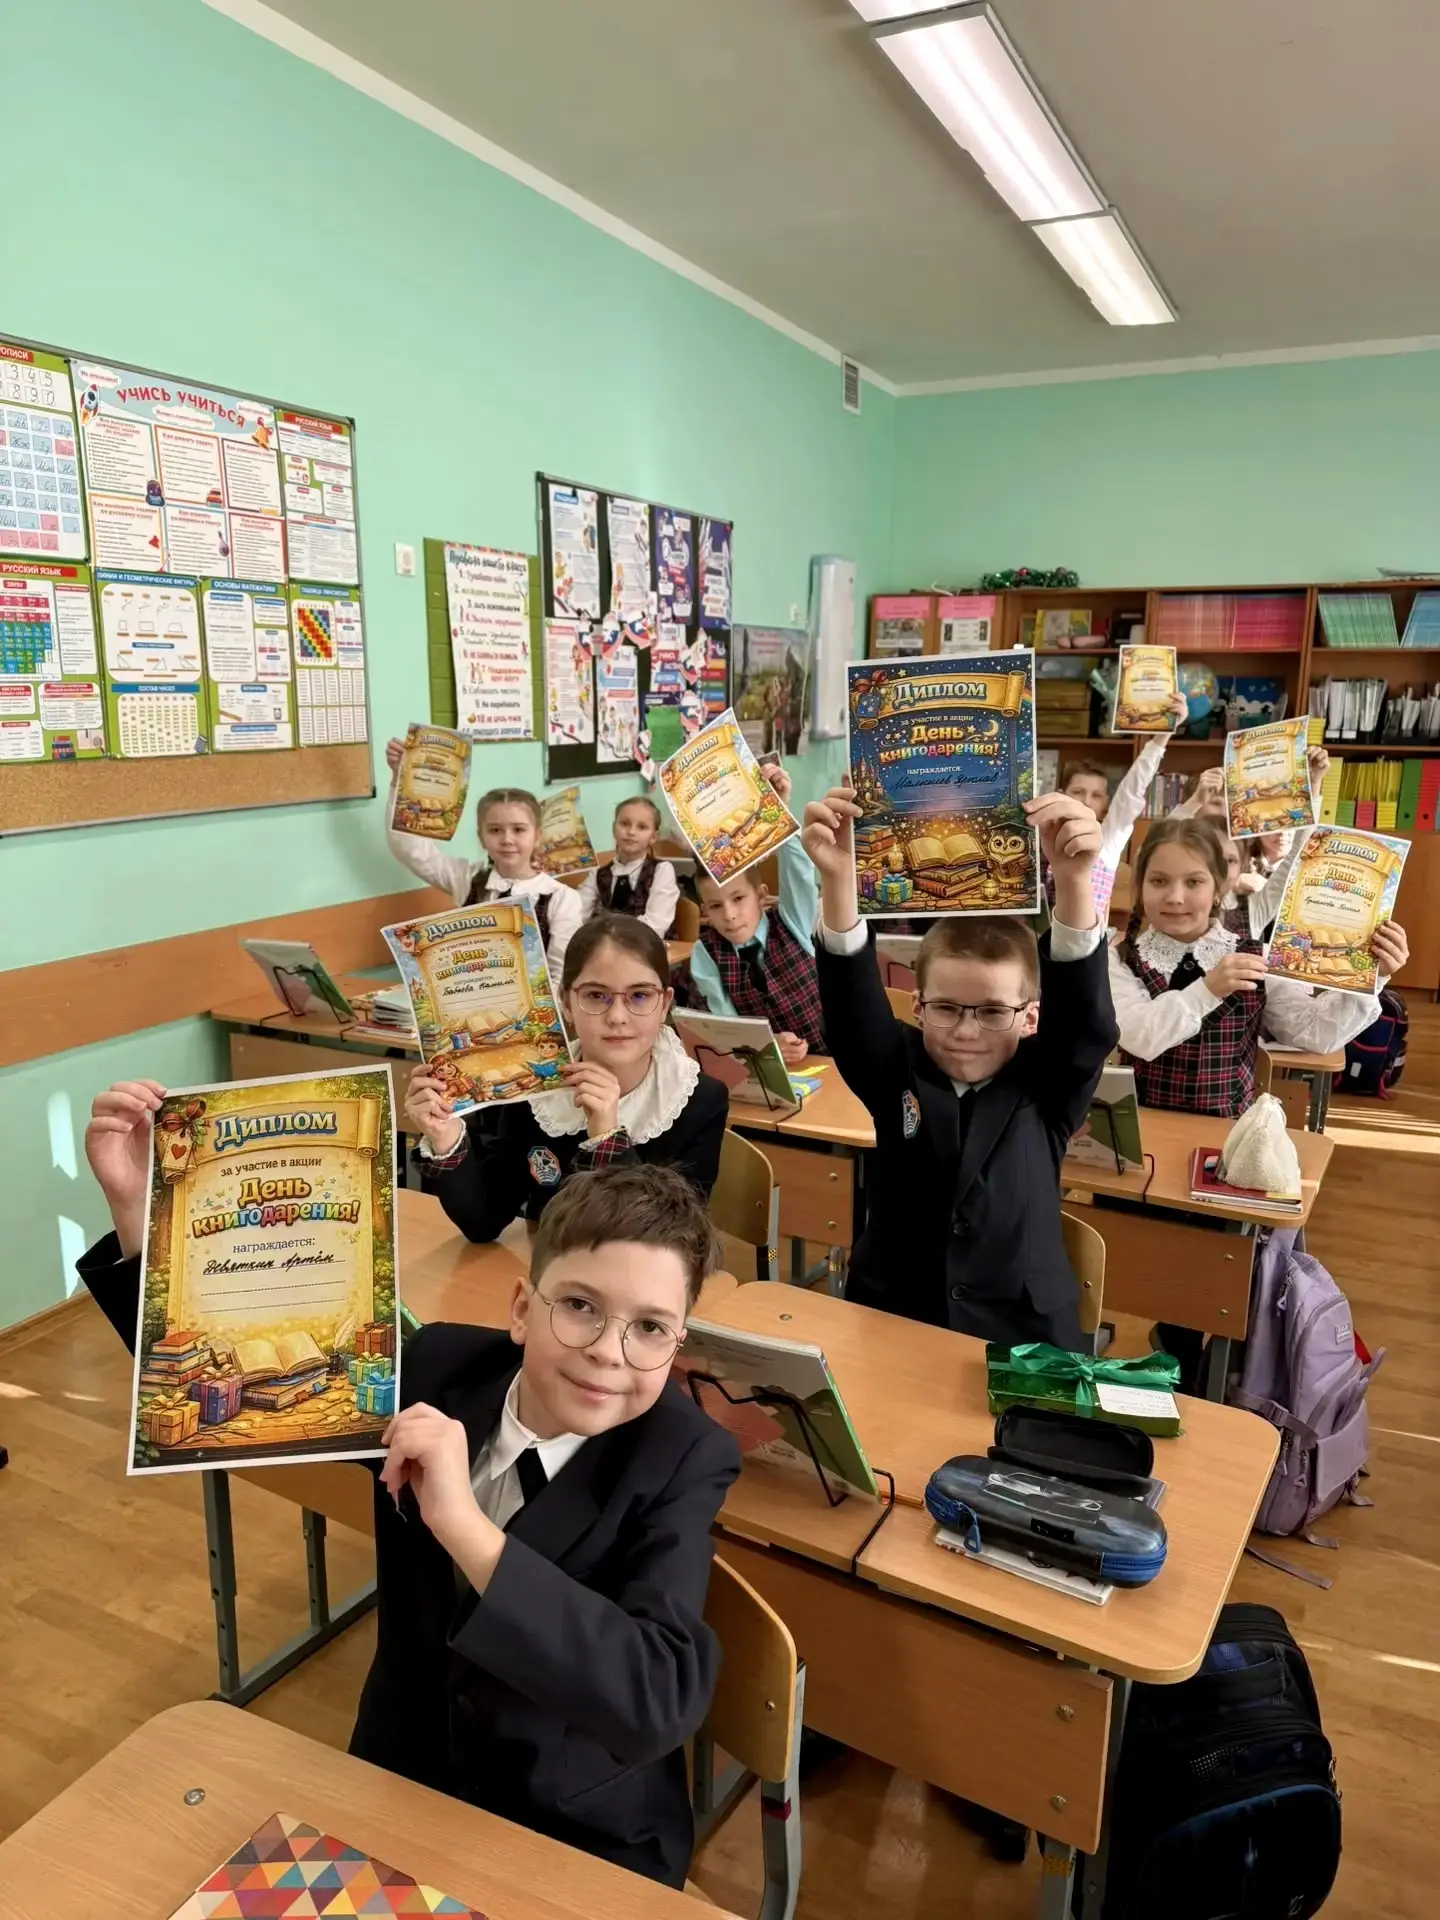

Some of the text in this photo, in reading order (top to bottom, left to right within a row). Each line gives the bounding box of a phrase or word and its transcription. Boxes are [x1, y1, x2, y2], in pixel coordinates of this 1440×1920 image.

[0, 346, 29, 361] ОПИСИ
[117, 386, 171, 404] УЧИСЬ
[175, 390, 245, 428] УЧИТЬСЯ
[2, 564, 62, 577] РУССКИЙ ЯЗЫК
[97, 571, 118, 581] ЛИНИИ
[124, 574, 173, 585] ГЕОМЕТРИЧЕСКИЕ
[174, 578, 195, 587] ФИГУРЫ
[214, 580, 276, 593] ОСНОВЫ МАТЕМАТИКИ
[911, 716, 942, 726] участие
[950, 715, 974, 723] акции
[910, 724, 965, 745] День
[879, 743, 999, 764] книгодарения!
[906, 764, 963, 775] награждается:
[1325, 867, 1357, 884] День
[452, 948, 489, 965] День
[435, 957, 515, 981] книгодарения!
[220, 1157, 323, 1177] за участие в акции
[237, 1176, 312, 1209] День
[191, 1199, 361, 1239] книгодарения!
[232, 1236, 317, 1254] награждается:
